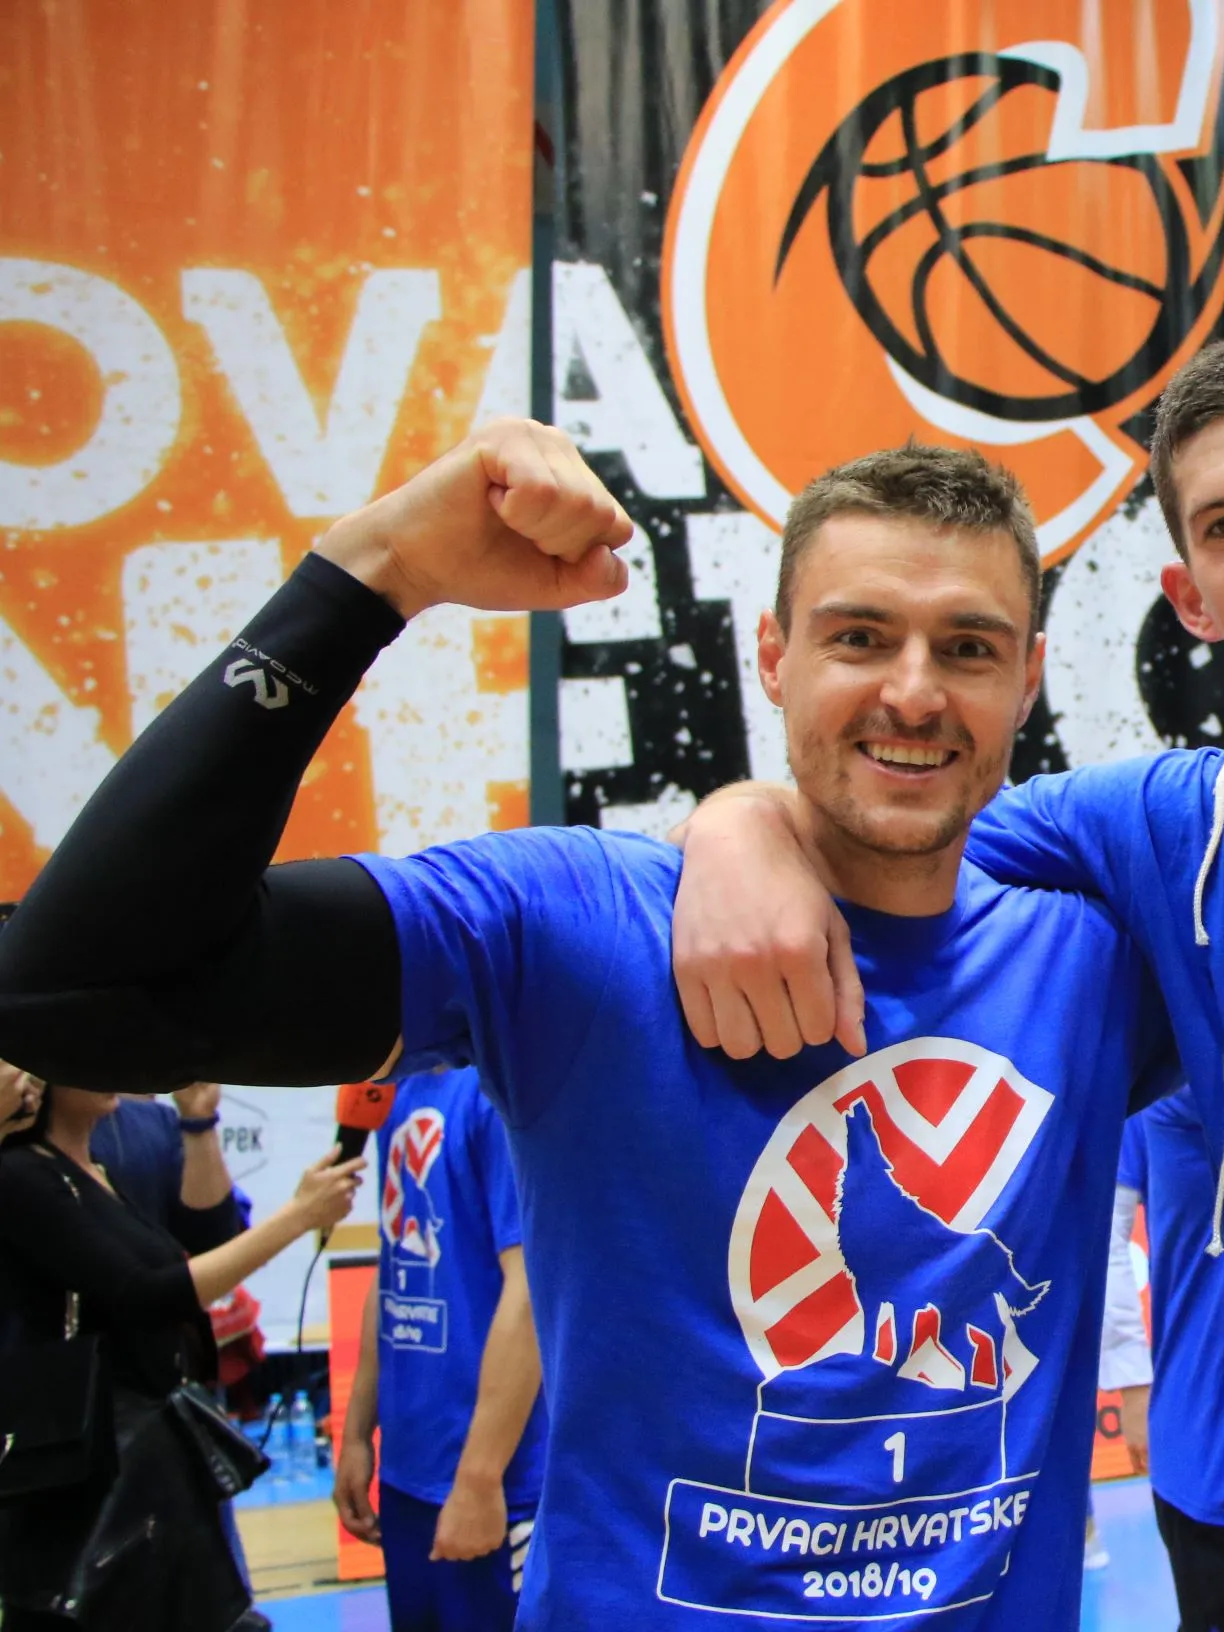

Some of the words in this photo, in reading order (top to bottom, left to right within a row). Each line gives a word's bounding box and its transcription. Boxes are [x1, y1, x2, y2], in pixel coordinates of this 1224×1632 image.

[884, 1431, 906, 1483] 1
[699, 1502, 847, 1555] PRVACI
[851, 1490, 1031, 1552] HRVATSKE
[802, 1561, 938, 1601] 2018/19
